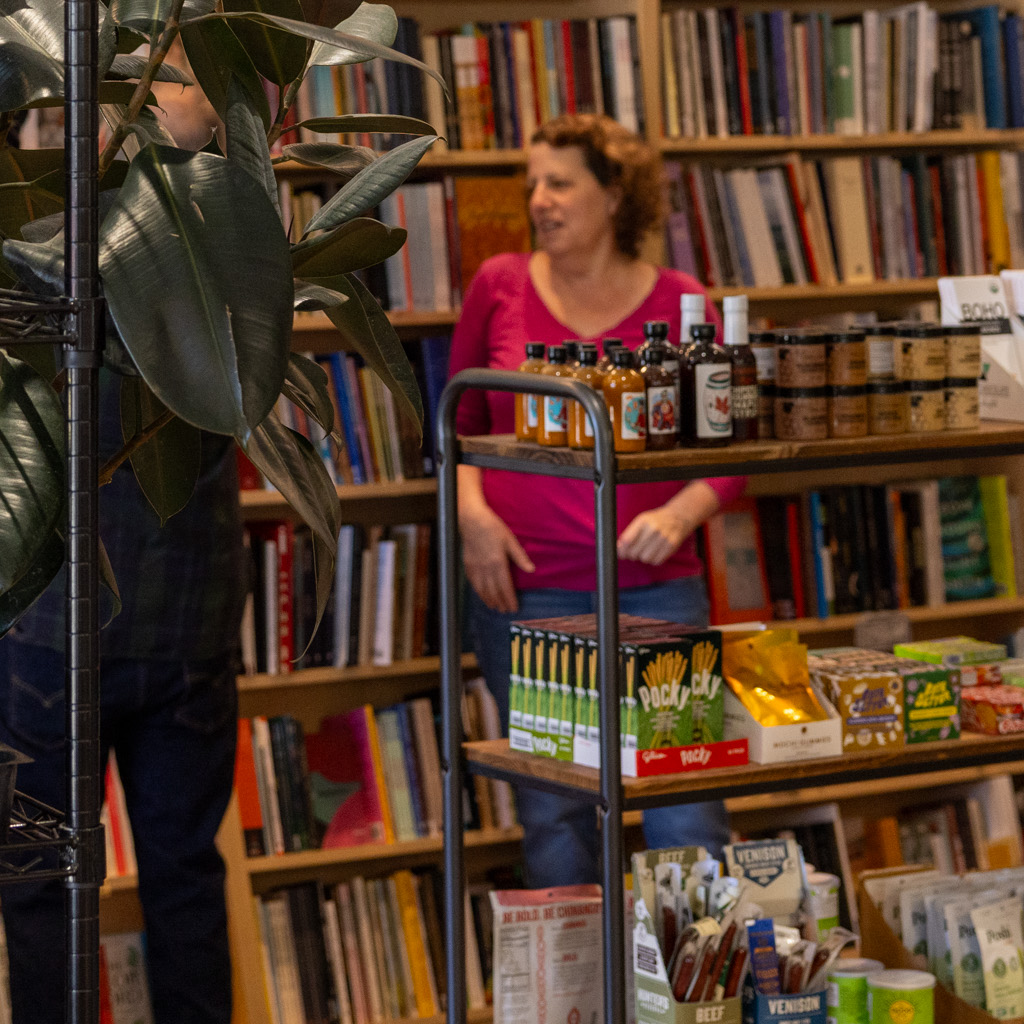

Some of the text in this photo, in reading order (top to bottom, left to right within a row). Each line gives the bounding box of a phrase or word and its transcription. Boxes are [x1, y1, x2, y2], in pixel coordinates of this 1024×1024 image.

[736, 845, 787, 864] VENISON
[695, 1005, 725, 1023] BEEF
[768, 994, 821, 1016] VENISON
